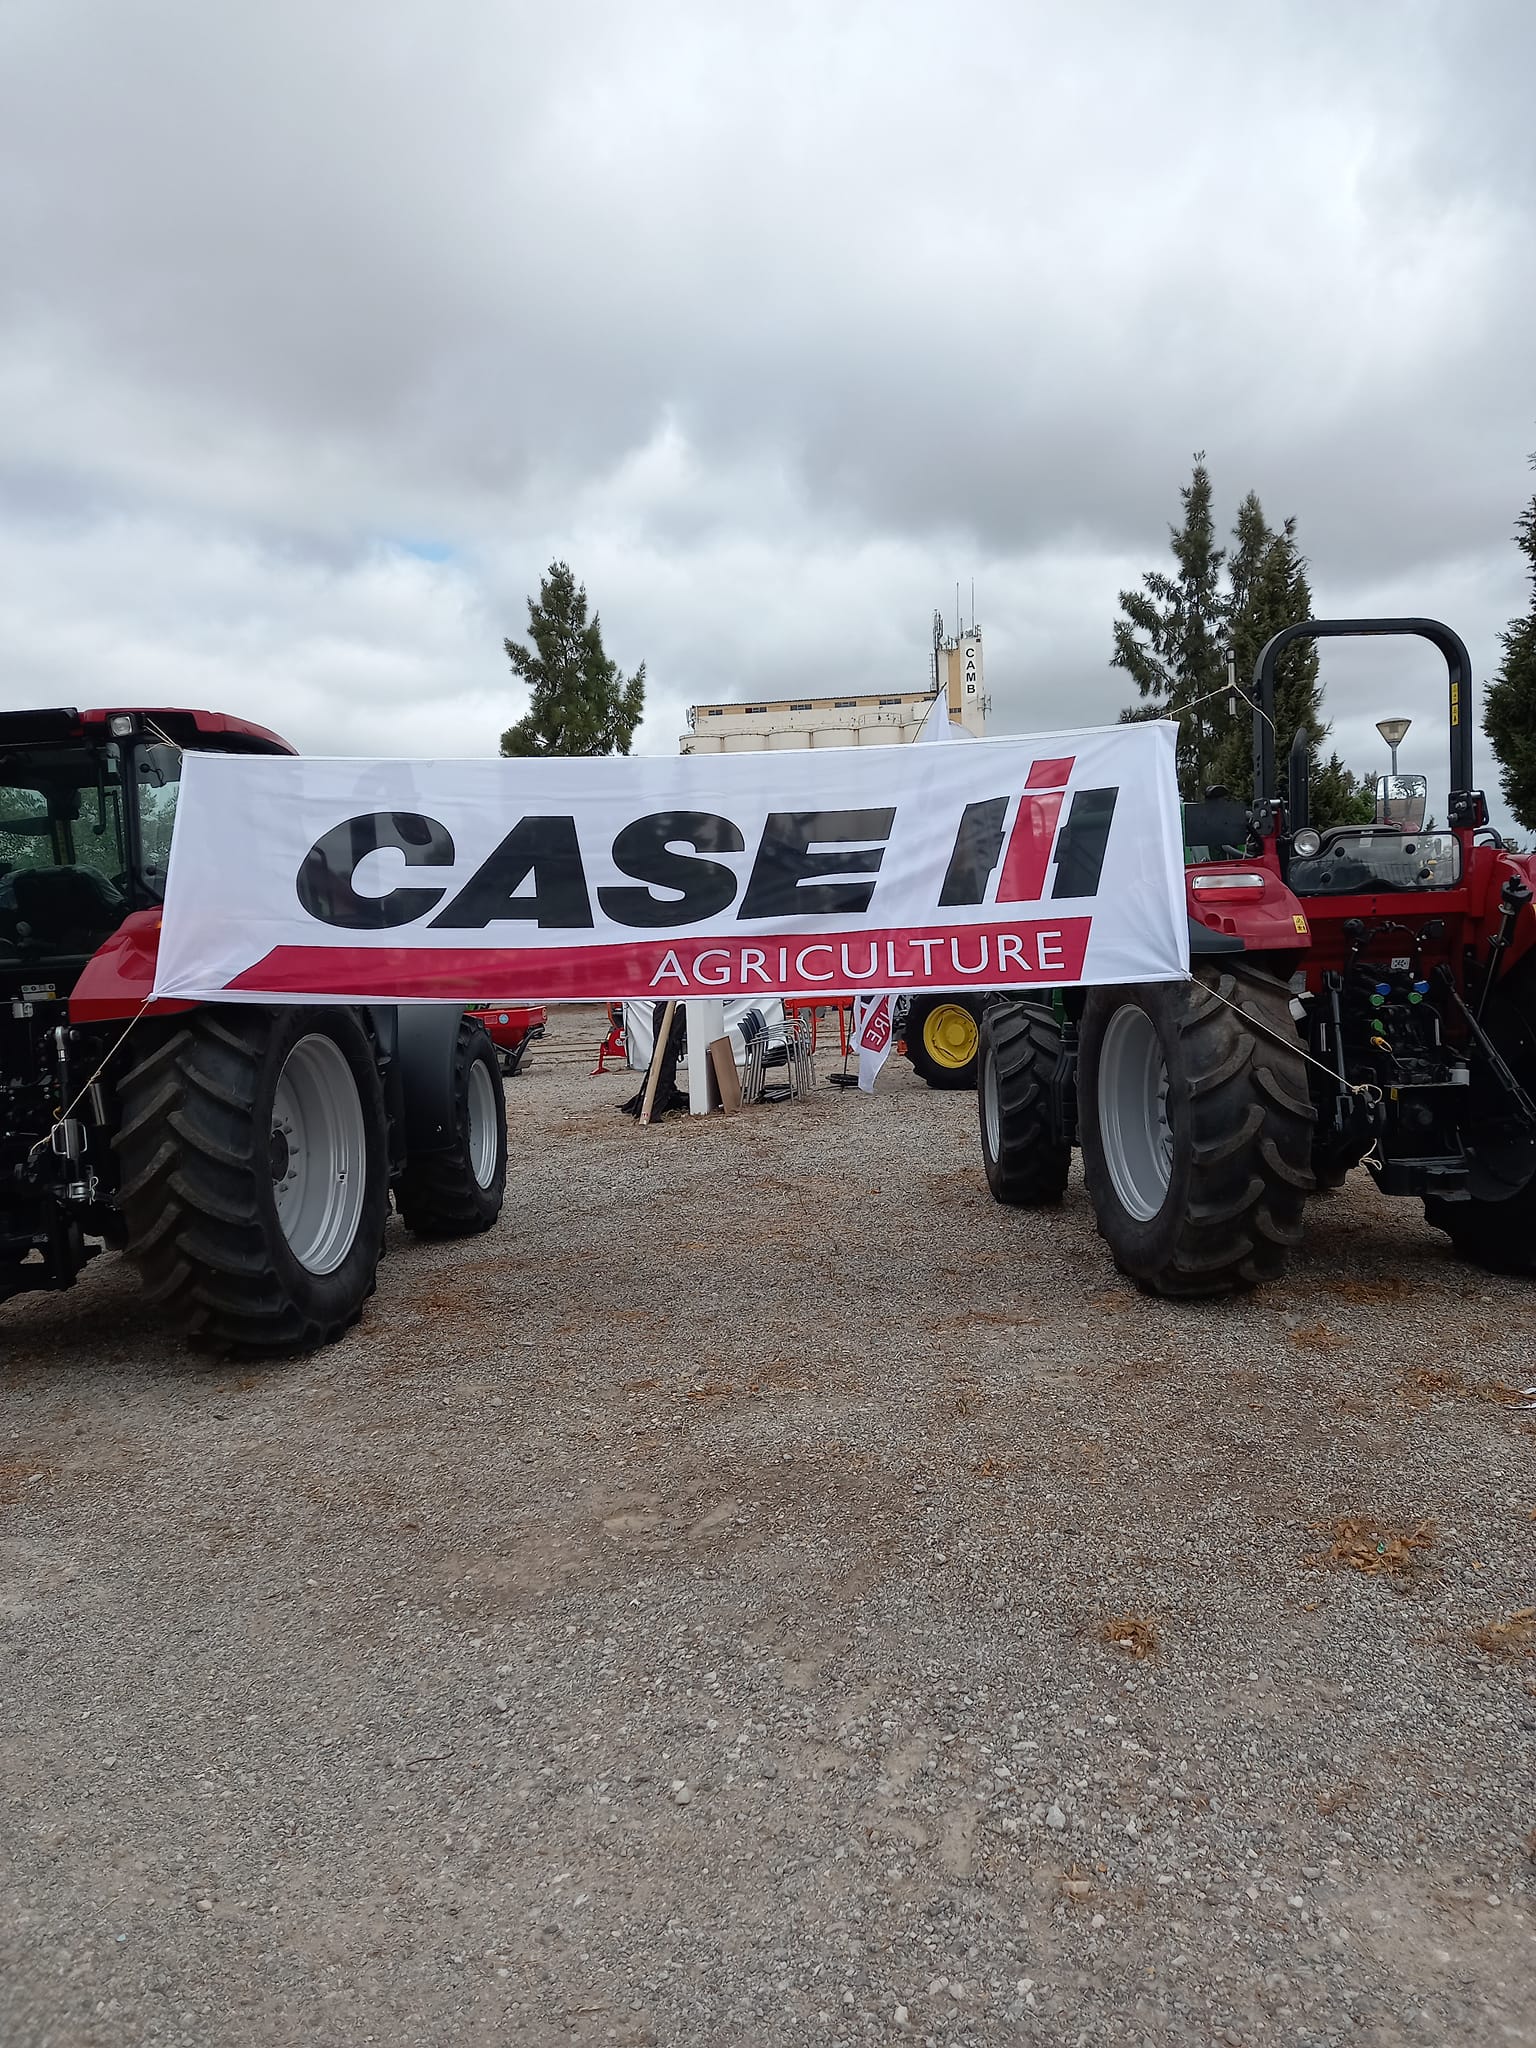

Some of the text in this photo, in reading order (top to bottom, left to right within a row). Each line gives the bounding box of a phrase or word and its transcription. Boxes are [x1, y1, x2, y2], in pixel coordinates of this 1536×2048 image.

[966, 648, 976, 694] CAMB
[296, 806, 897, 930] CASE
[648, 930, 1066, 987] AGRICULTURE
